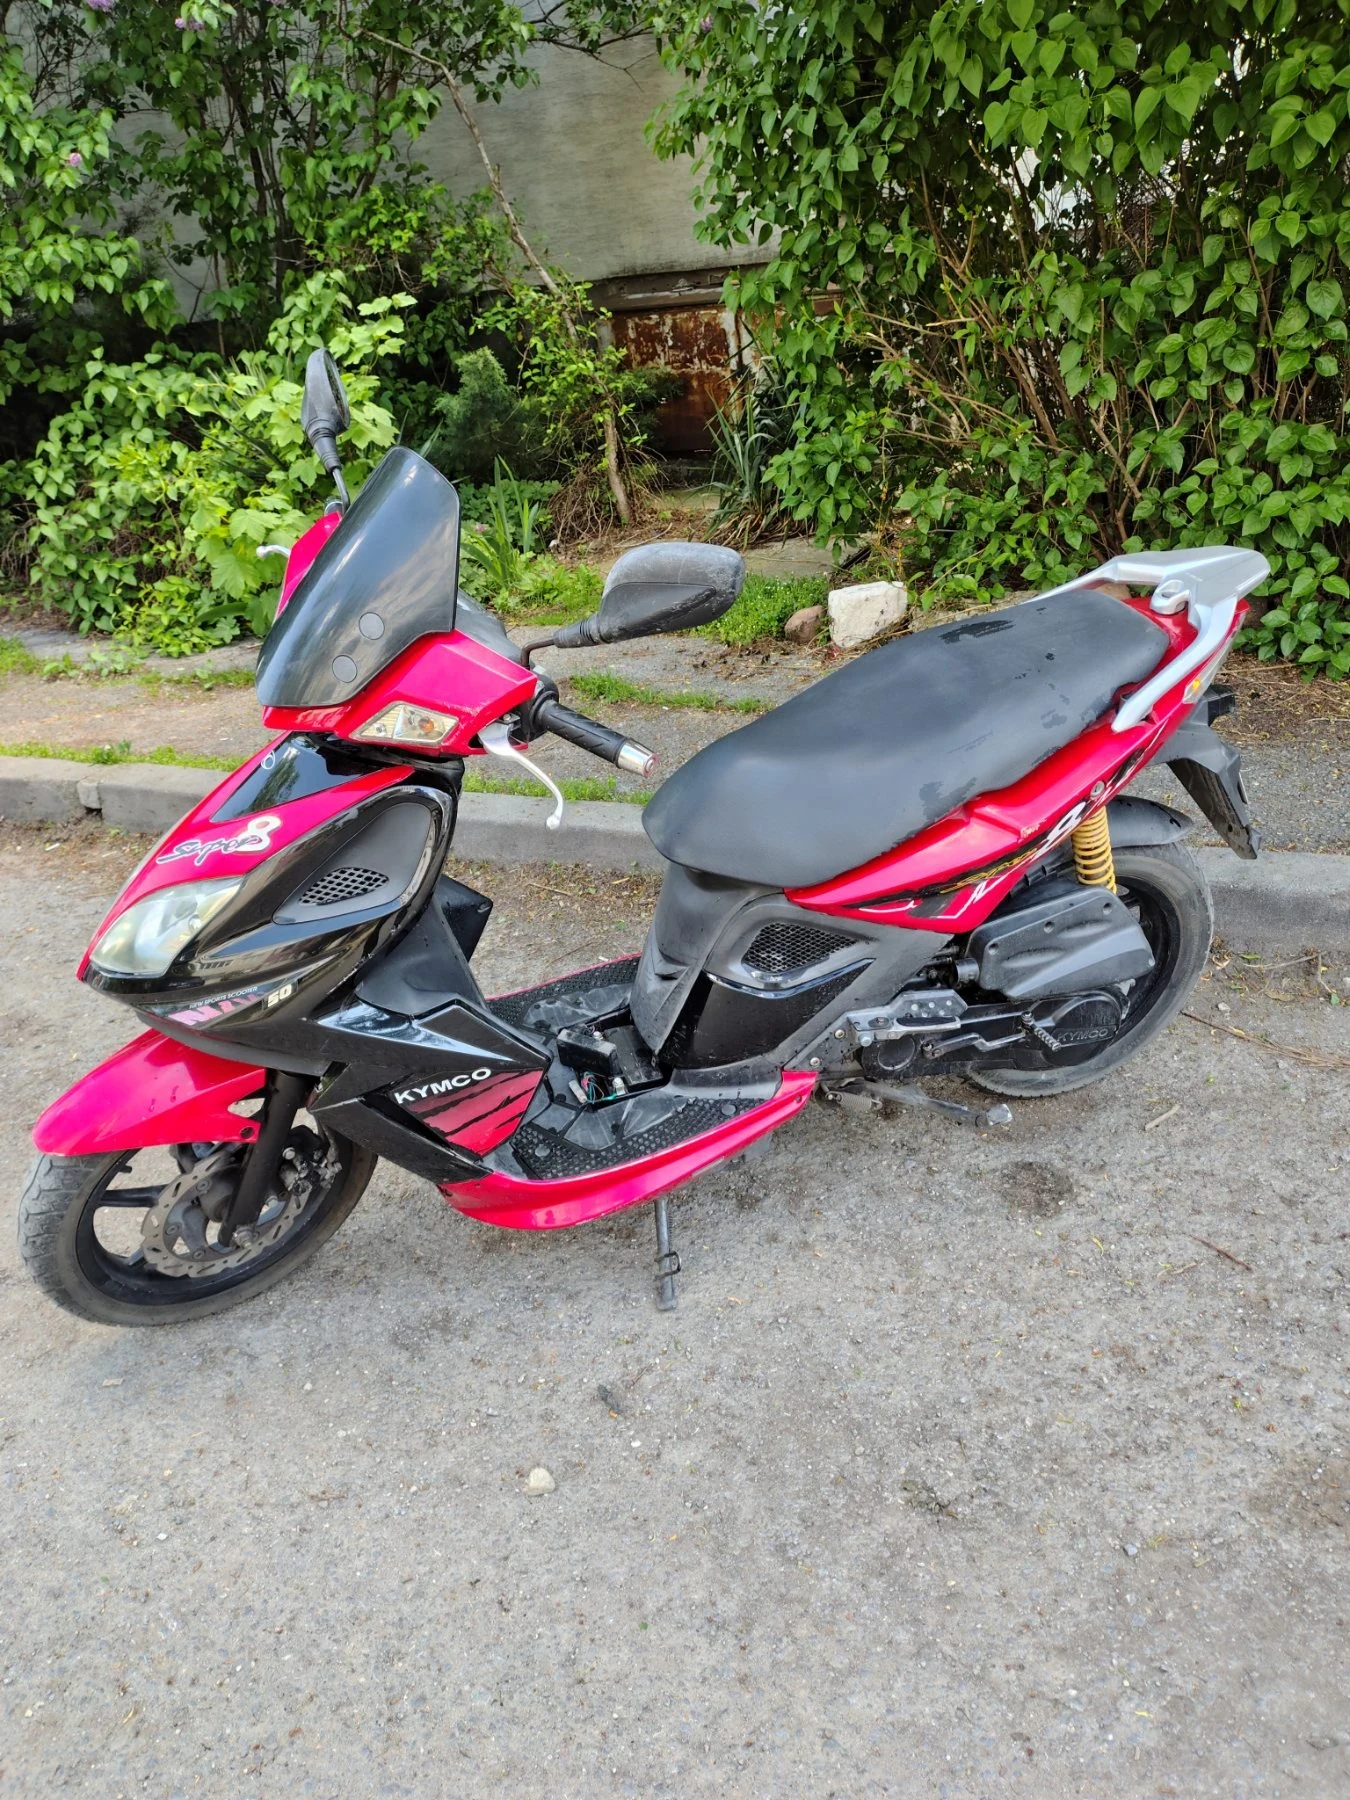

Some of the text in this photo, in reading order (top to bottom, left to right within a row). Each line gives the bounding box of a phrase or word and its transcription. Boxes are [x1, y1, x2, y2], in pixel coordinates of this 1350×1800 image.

[267, 984, 292, 1008] 50
[1057, 1028, 1109, 1042] KYMCO
[394, 1067, 492, 1104] KYMCO
